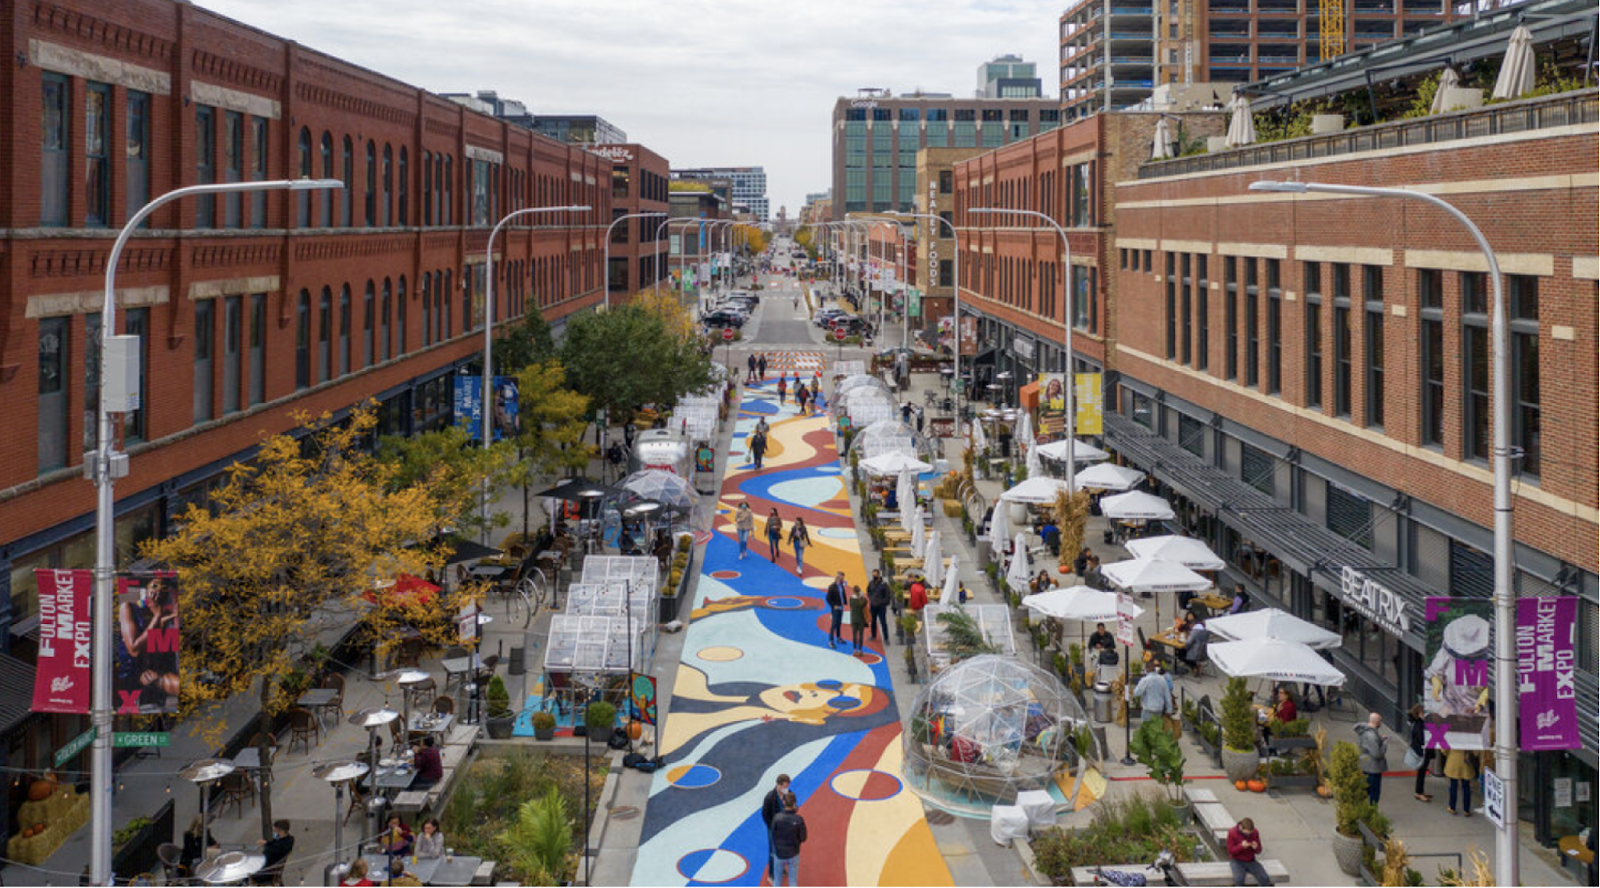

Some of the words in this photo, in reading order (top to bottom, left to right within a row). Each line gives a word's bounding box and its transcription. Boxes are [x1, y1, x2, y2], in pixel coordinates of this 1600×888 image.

[850, 99, 878, 109] Google
[928, 241, 938, 287] FOODS
[54, 568, 74, 640] MARKET
[1342, 565, 1409, 630] BEATRIX
[1425, 597, 1451, 621] F
[38, 594, 55, 658] FULTON
[1536, 597, 1557, 672] MARKET
[73, 621, 90, 669] EXPO
[147, 628, 180, 653] M
[1455, 659, 1488, 686] M
[1517, 625, 1536, 693] FULTON
[1556, 649, 1576, 700] EXPO
[117, 690, 142, 715] X
[124, 734, 158, 746] GREEN
[1425, 723, 1451, 749] X
[1486, 773, 1502, 796] ONE
[1486, 788, 1502, 809] WAY
